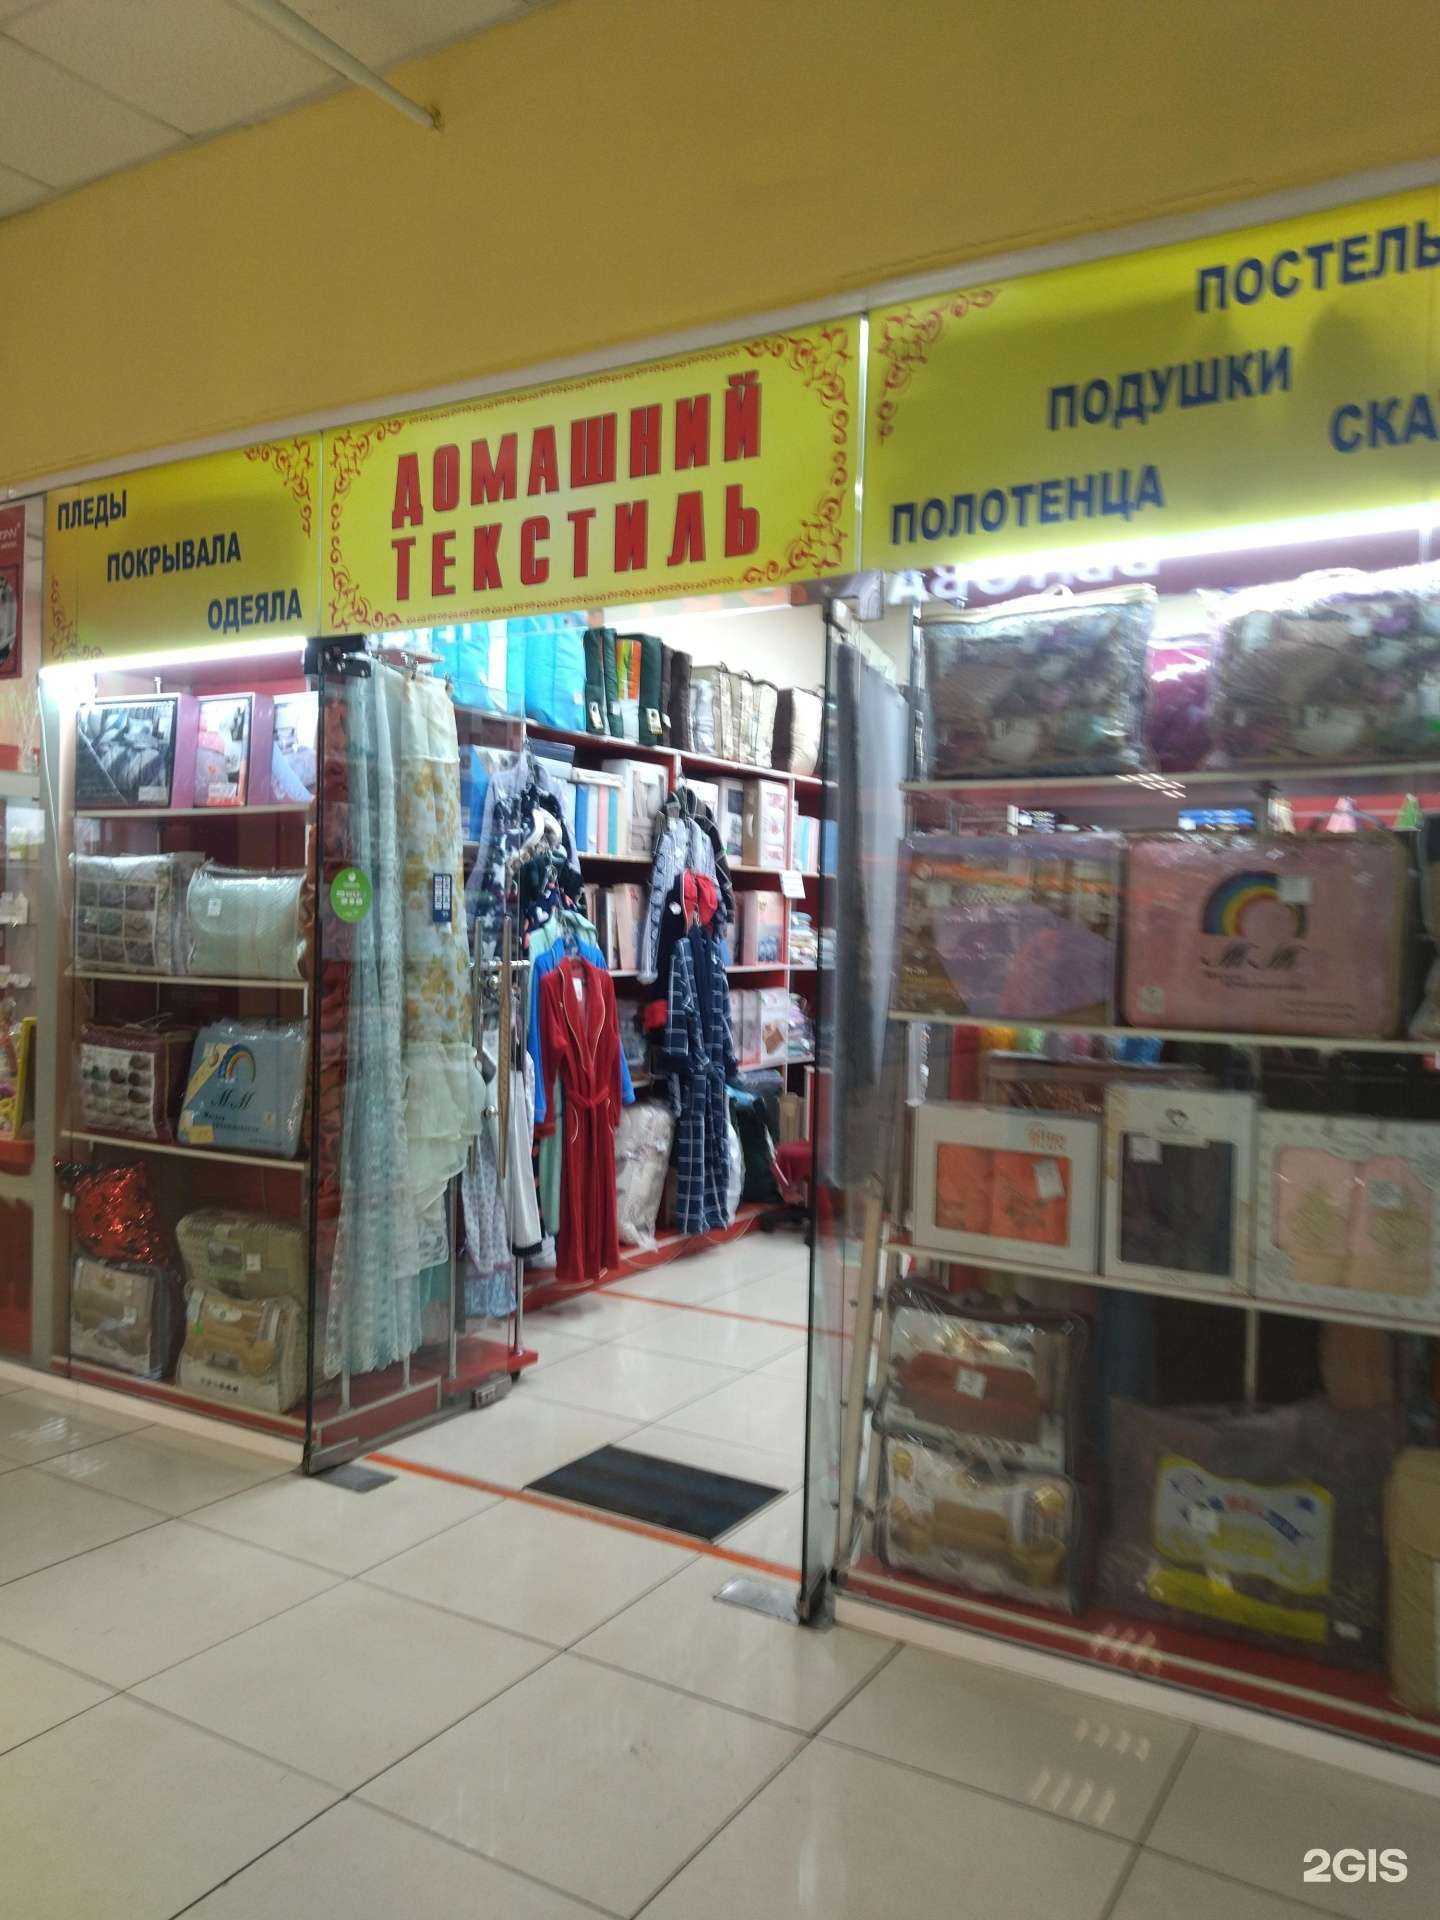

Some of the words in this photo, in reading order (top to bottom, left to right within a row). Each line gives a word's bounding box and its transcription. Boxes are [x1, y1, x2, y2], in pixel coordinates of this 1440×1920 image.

[1196, 220, 1440, 312] ПОСТЕЛЬ
[1047, 346, 1291, 430] ПОДУШКИ
[391, 370, 762, 529] ДОМАШНИЙ
[56, 490, 127, 530] ПЛЕДЫ
[391, 483, 761, 600] ТЕКСТИЛЬ
[890, 465, 1164, 544] ПОЛОТЕНЦА
[106, 532, 241, 582] ПОКРЫВАЛА
[207, 588, 302, 633] ОДЕЯЛА
